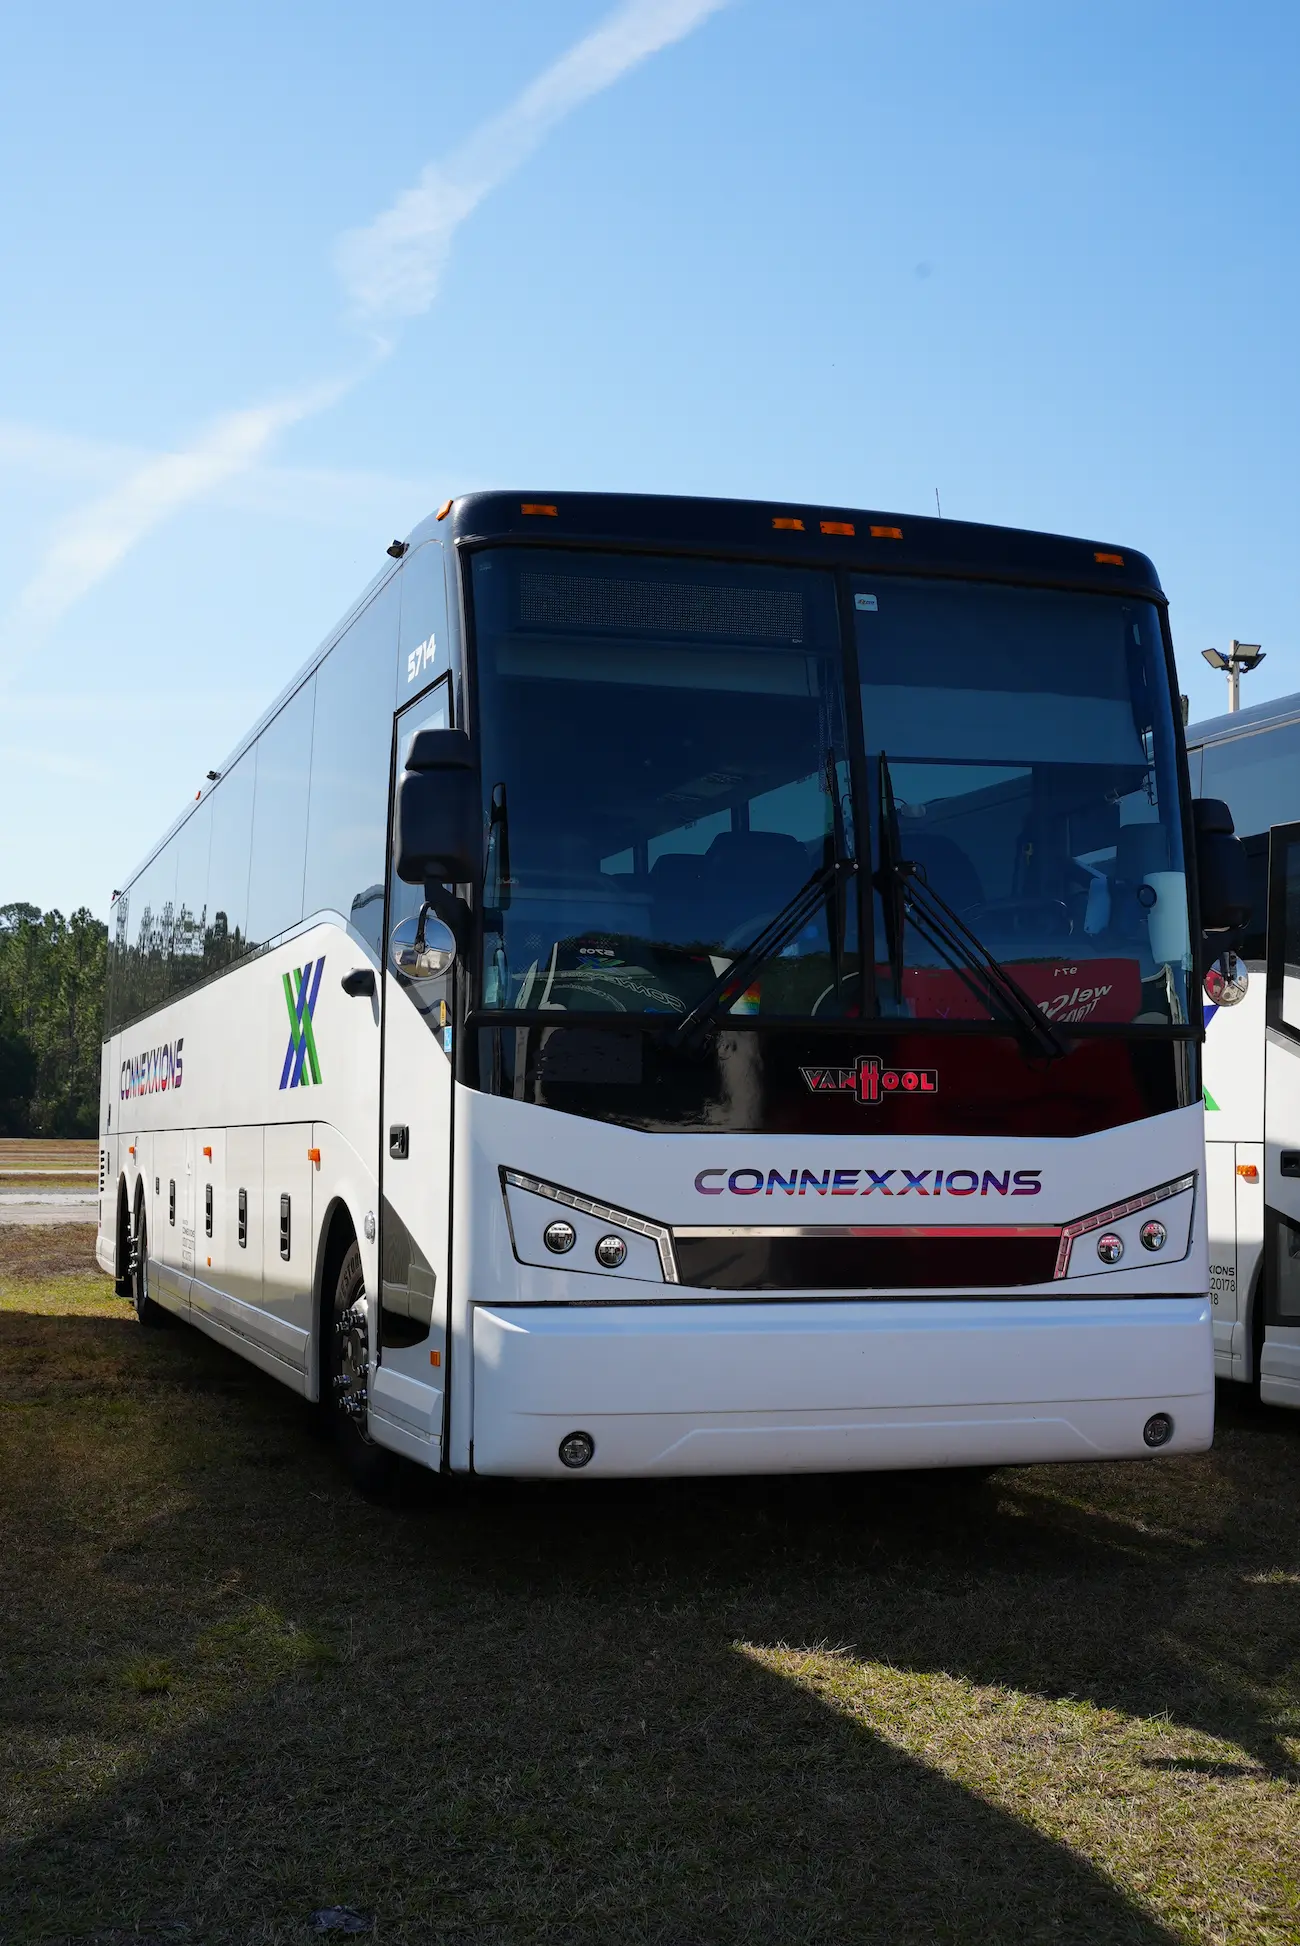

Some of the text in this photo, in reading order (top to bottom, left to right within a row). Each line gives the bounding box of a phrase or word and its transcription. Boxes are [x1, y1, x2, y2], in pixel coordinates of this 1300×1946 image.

[407, 632, 436, 683] 5714
[121, 1038, 184, 1100] CONNEXXIONS
[806, 1061, 934, 1100] VAN HOOL
[694, 1168, 1043, 1196] CONNEXXIONS
